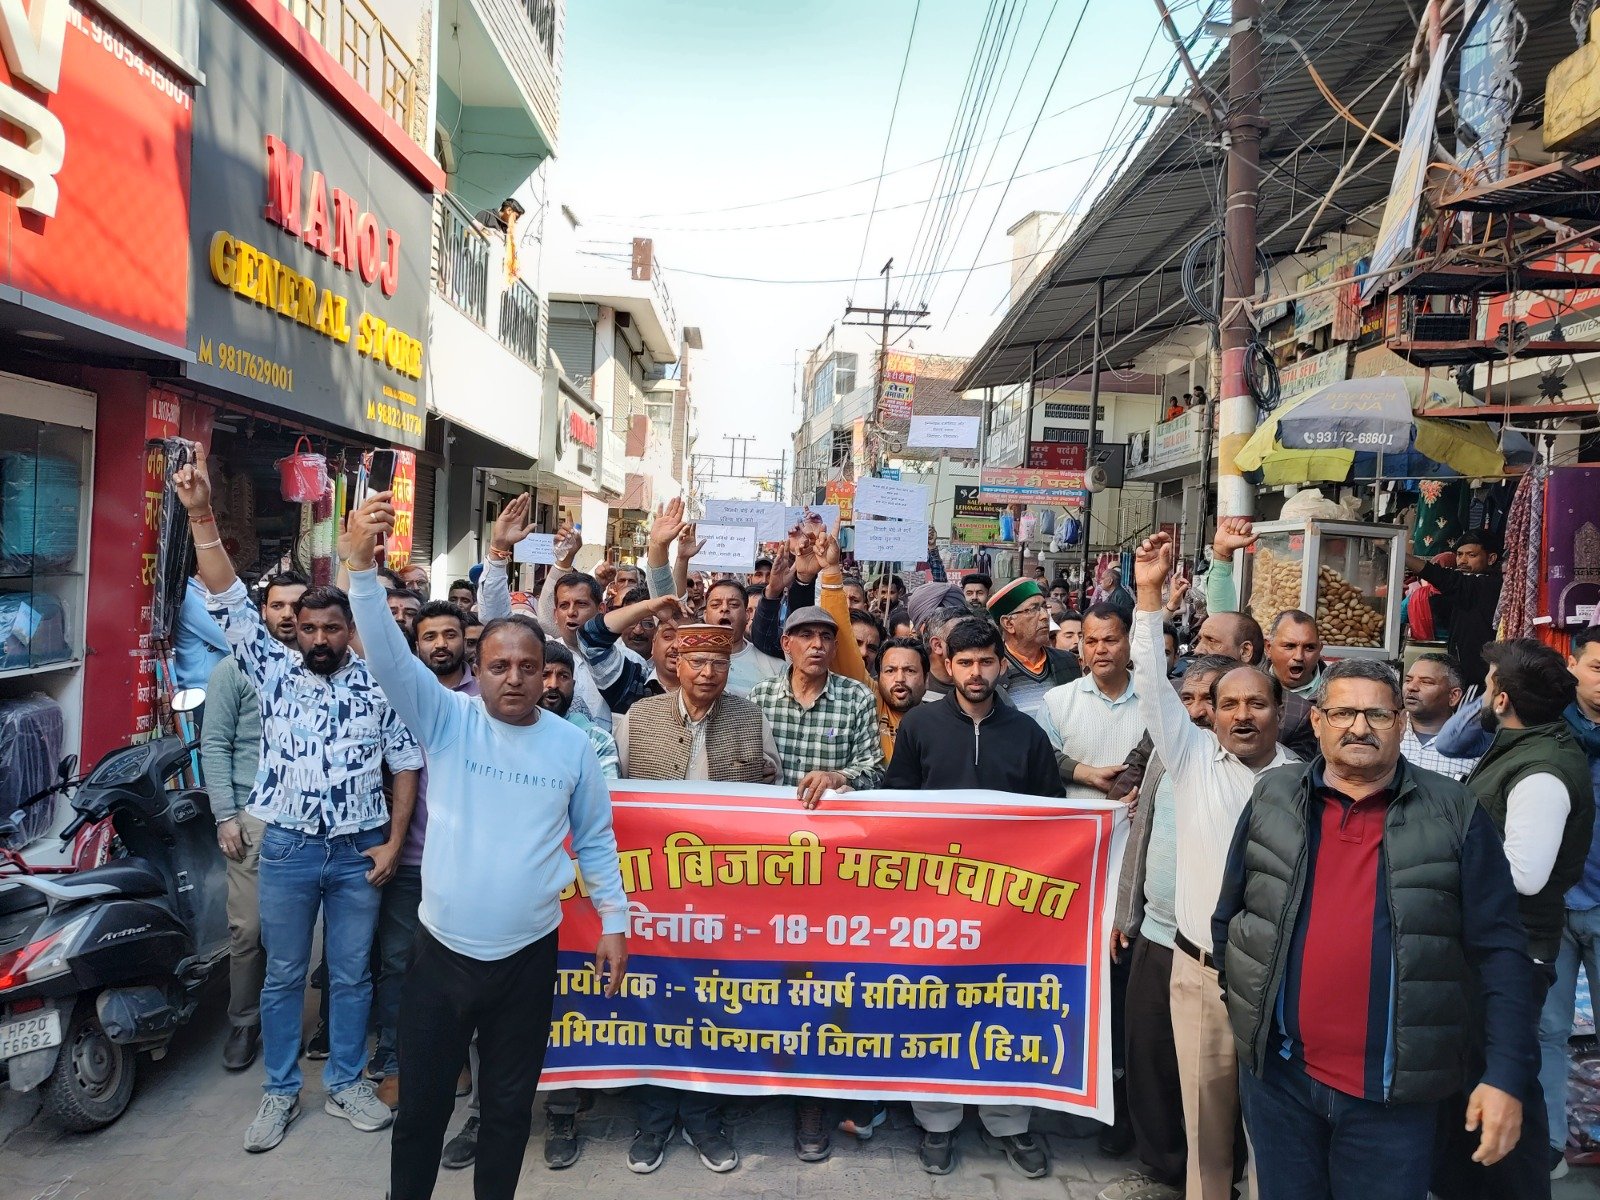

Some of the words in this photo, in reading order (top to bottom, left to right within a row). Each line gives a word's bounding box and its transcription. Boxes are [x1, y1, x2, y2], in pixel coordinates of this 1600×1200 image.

[264, 134, 401, 298] MANOJ
[209, 230, 351, 344] GENERAL
[356, 312, 423, 380] STORE
[198, 335, 213, 366] M
[218, 342, 293, 393] 9817629001
[367, 399, 376, 420] M
[1331, 401, 1383, 411] UNA
[1316, 431, 1393, 446] 93172-68601
[984, 474, 1019, 487] परदे
[1024, 474, 1044, 488] ही
[1047, 477, 1083, 489] परदे
[508, 772, 547, 787] JEANS
[663, 831, 827, 889] बिजली
[836, 842, 1082, 920] महापंचायत
[625, 901, 727, 945] दिनांक
[768, 914, 982, 951] 18-02-2025
[694, 968, 782, 1015] संयुक्त
[787, 971, 856, 1008] संघर्ष
[861, 973, 950, 1010] समिति
[955, 973, 1071, 1019] कर्मचारी,
[3, 1032, 52, 1056] F6682
[9, 1017, 47, 1039] HP20
[653, 1017, 695, 1050] एवं
[817, 1023, 895, 1059] जिला
[900, 1032, 962, 1060] ऊना
